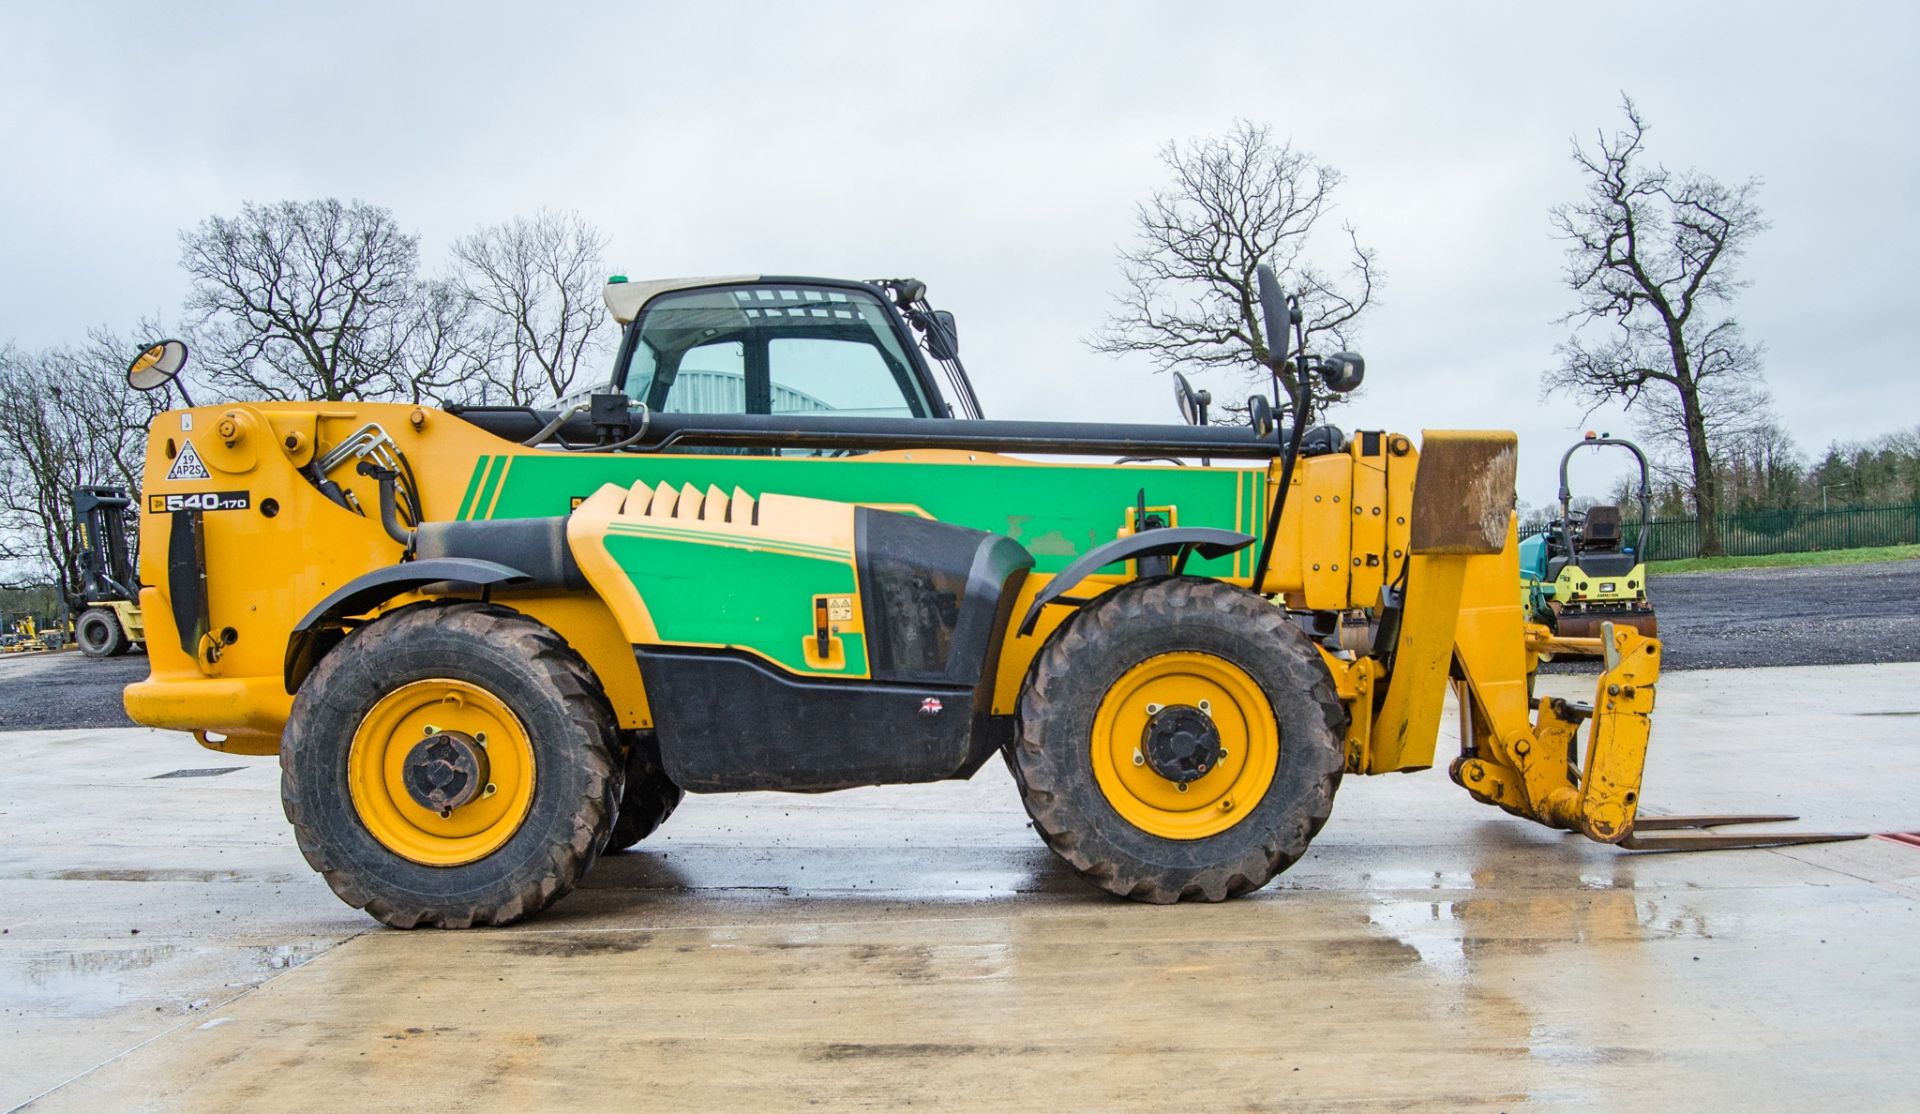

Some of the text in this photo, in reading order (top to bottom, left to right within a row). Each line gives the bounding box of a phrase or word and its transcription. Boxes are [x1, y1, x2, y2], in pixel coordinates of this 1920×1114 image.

[183, 455, 194, 464] 19
[176, 465, 201, 475] AP2S
[166, 494, 246, 511] 540-170
